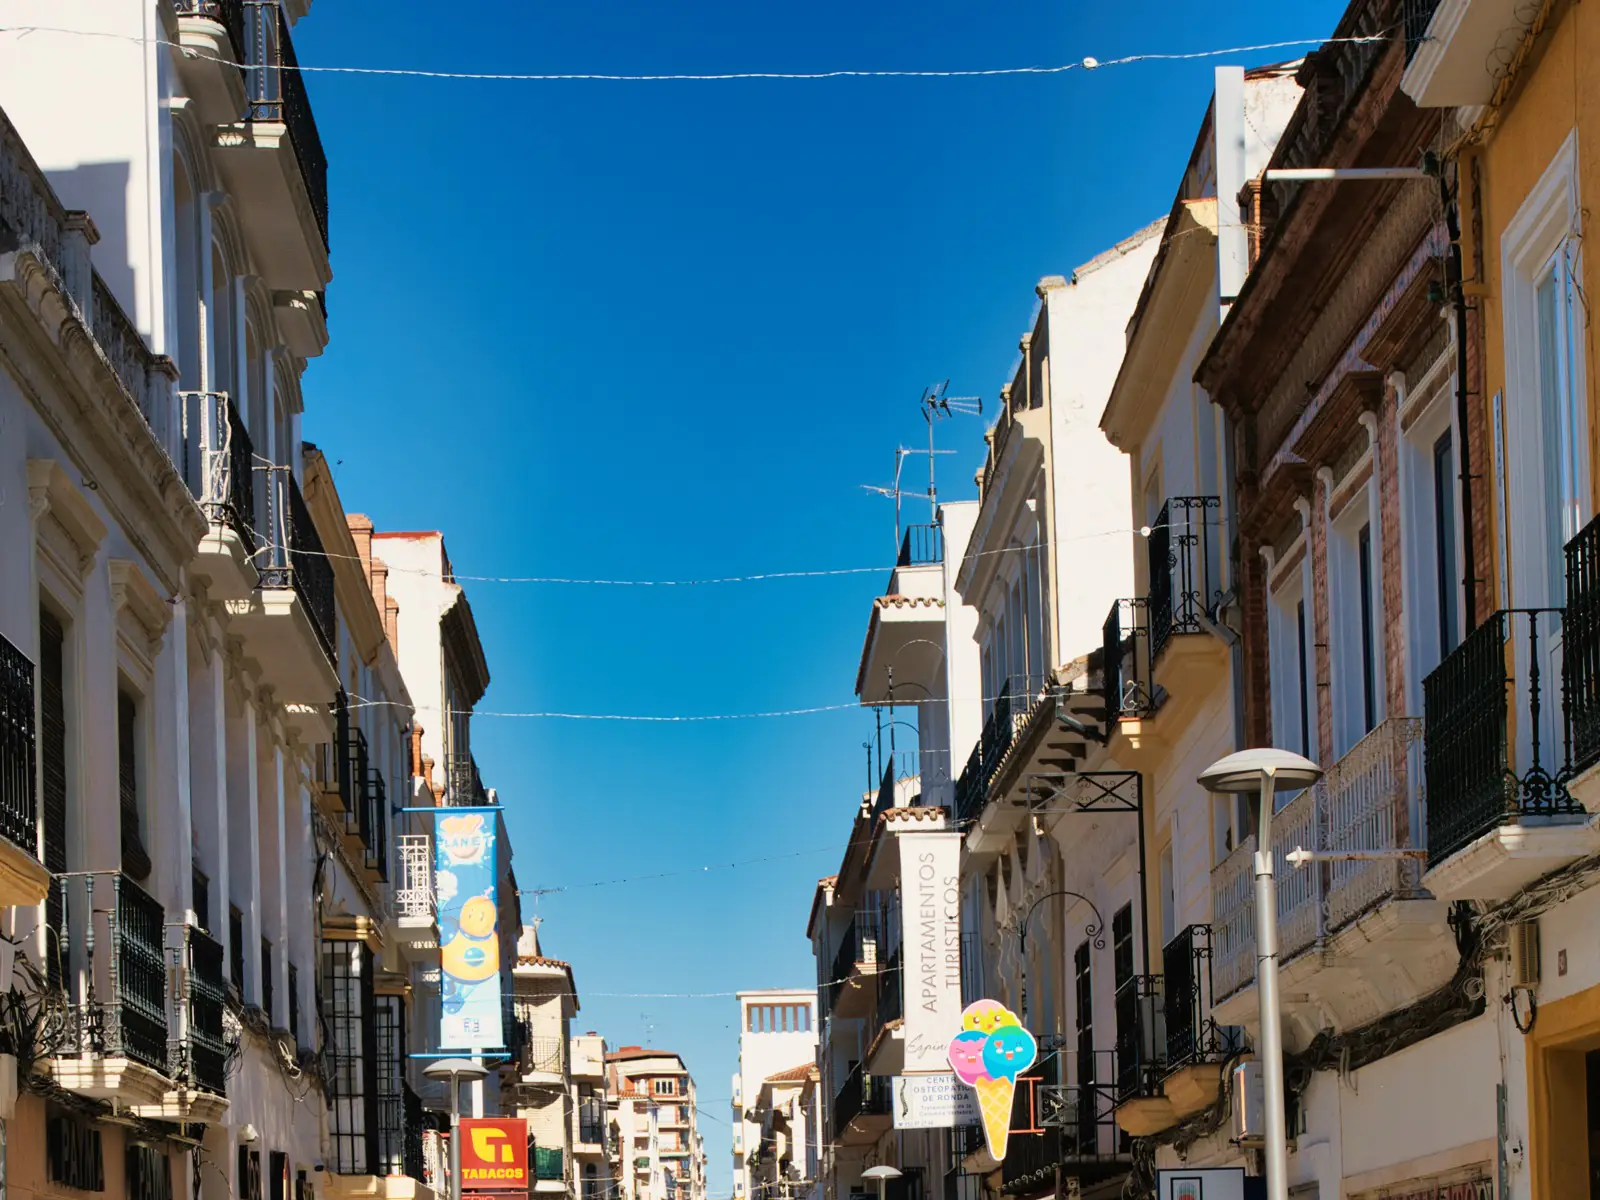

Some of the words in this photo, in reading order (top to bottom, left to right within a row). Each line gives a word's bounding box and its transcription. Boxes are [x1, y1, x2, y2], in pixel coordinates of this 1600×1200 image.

[919, 852, 938, 1013] APARTAMENTOS
[937, 1093, 969, 1101] RONDA
[461, 1168, 524, 1179] TABACOS
